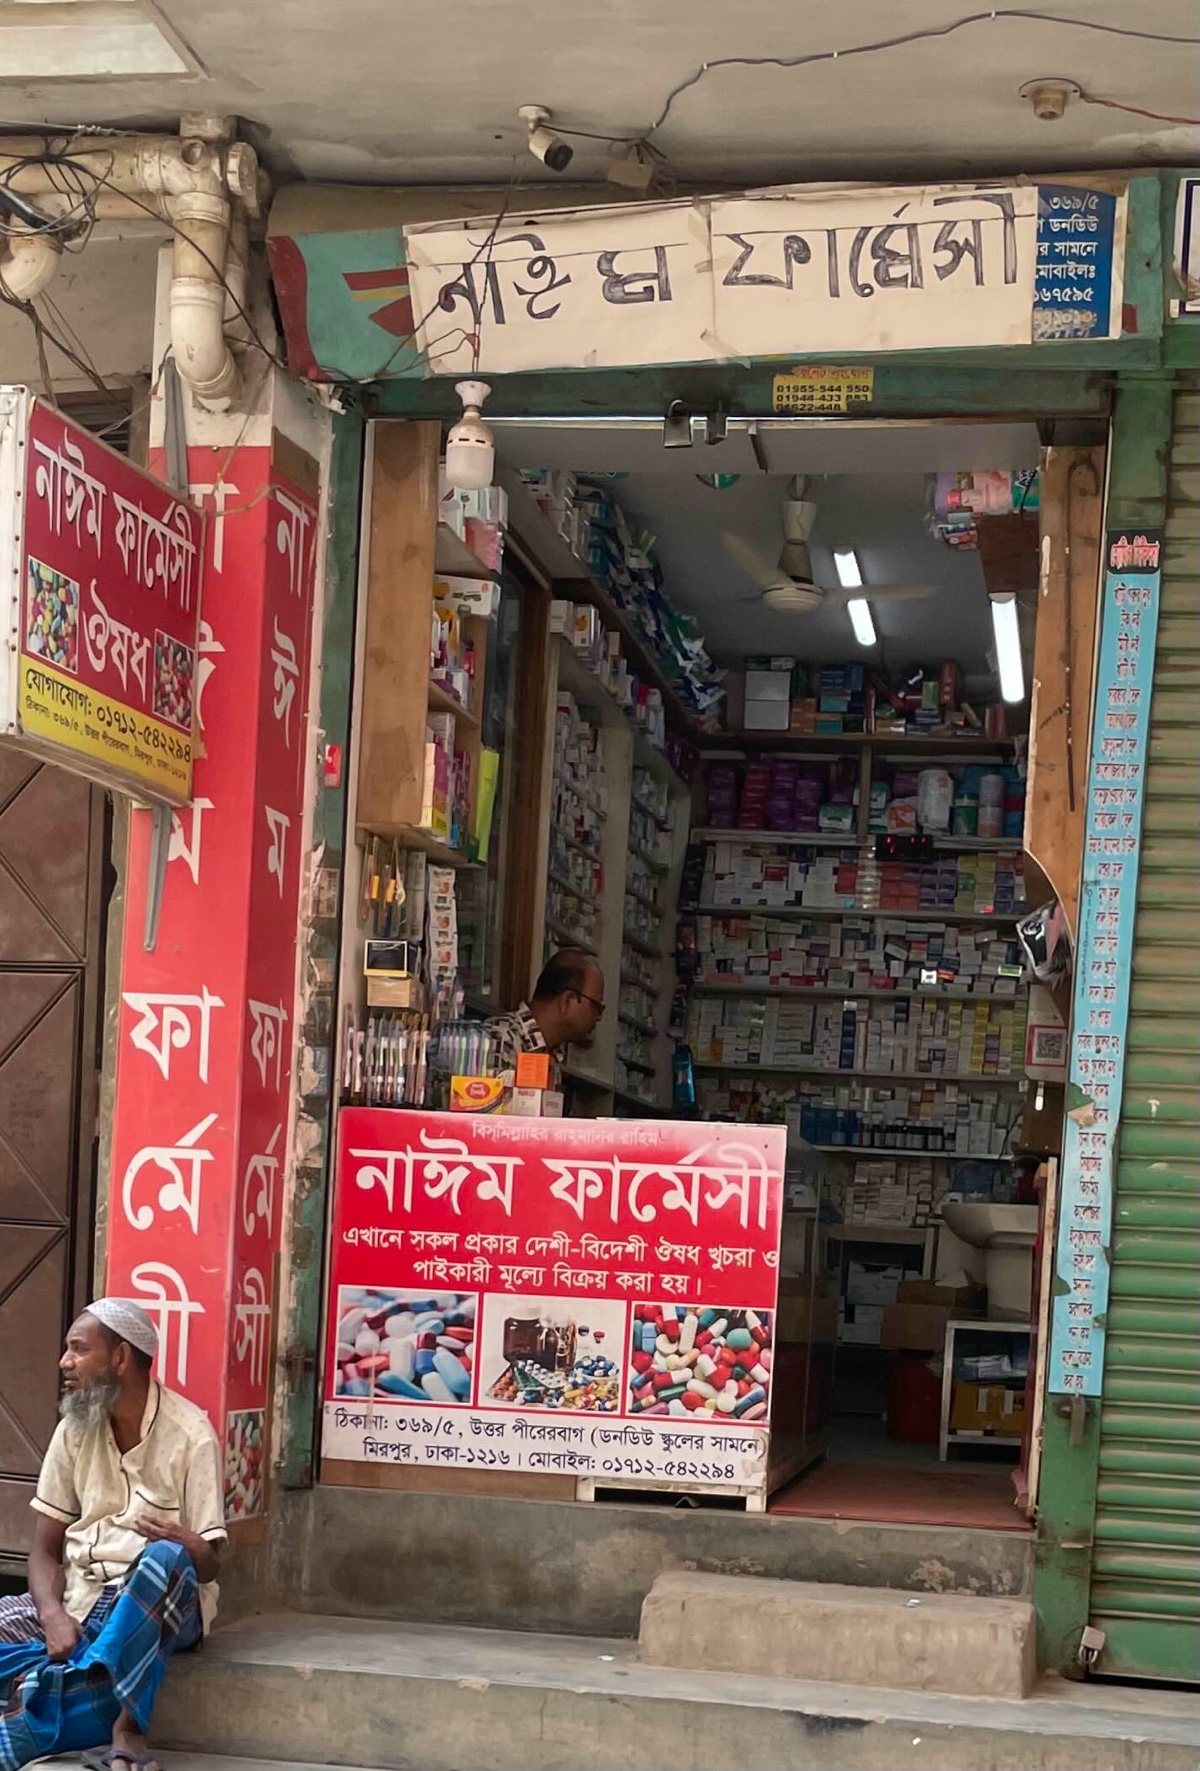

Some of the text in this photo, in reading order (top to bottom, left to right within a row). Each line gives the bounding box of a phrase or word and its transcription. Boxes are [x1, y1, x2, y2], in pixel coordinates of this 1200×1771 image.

[1049, 192, 1099, 212] ৩৬৯/৫
[1049, 213, 1099, 233] ডনডিউ
[1053, 241, 1098, 256] সামনে
[847, 385, 869, 393] 550
[34, 427, 197, 613] নাঈম ফার্মেসী
[83, 579, 150, 703] ঔষধ
[97, 706, 191, 763] ০১৭১২-৫৪২২৯৪
[348, 1127, 784, 1230] নাঈম ফার্মেসী
[343, 1226, 404, 1249] এখানে
[409, 1229, 460, 1251] সকল
[464, 1232, 519, 1254] প্রকার
[525, 1230, 648, 1262] দেশী-বিদেশী
[655, 1236, 701, 1265] ঔষধ
[708, 1244, 755, 1271] খুচরা
[413, 1255, 493, 1283] পাইকারী
[498, 1264, 546, 1291] মূল্যে
[552, 1262, 609, 1290] বিক্রয়
[615, 1270, 654, 1292] করা
[470, 1416, 506, 1437] উত্তর
[512, 1417, 584, 1443] পীরেরবাগ
[591, 1425, 654, 1448] (ডনডিউ
[660, 1432, 705, 1453] স্কুলের
[711, 1436, 767, 1459] সামনে)
[602, 1456, 734, 1479] ০১৭১২-৫৪২২৯৪
